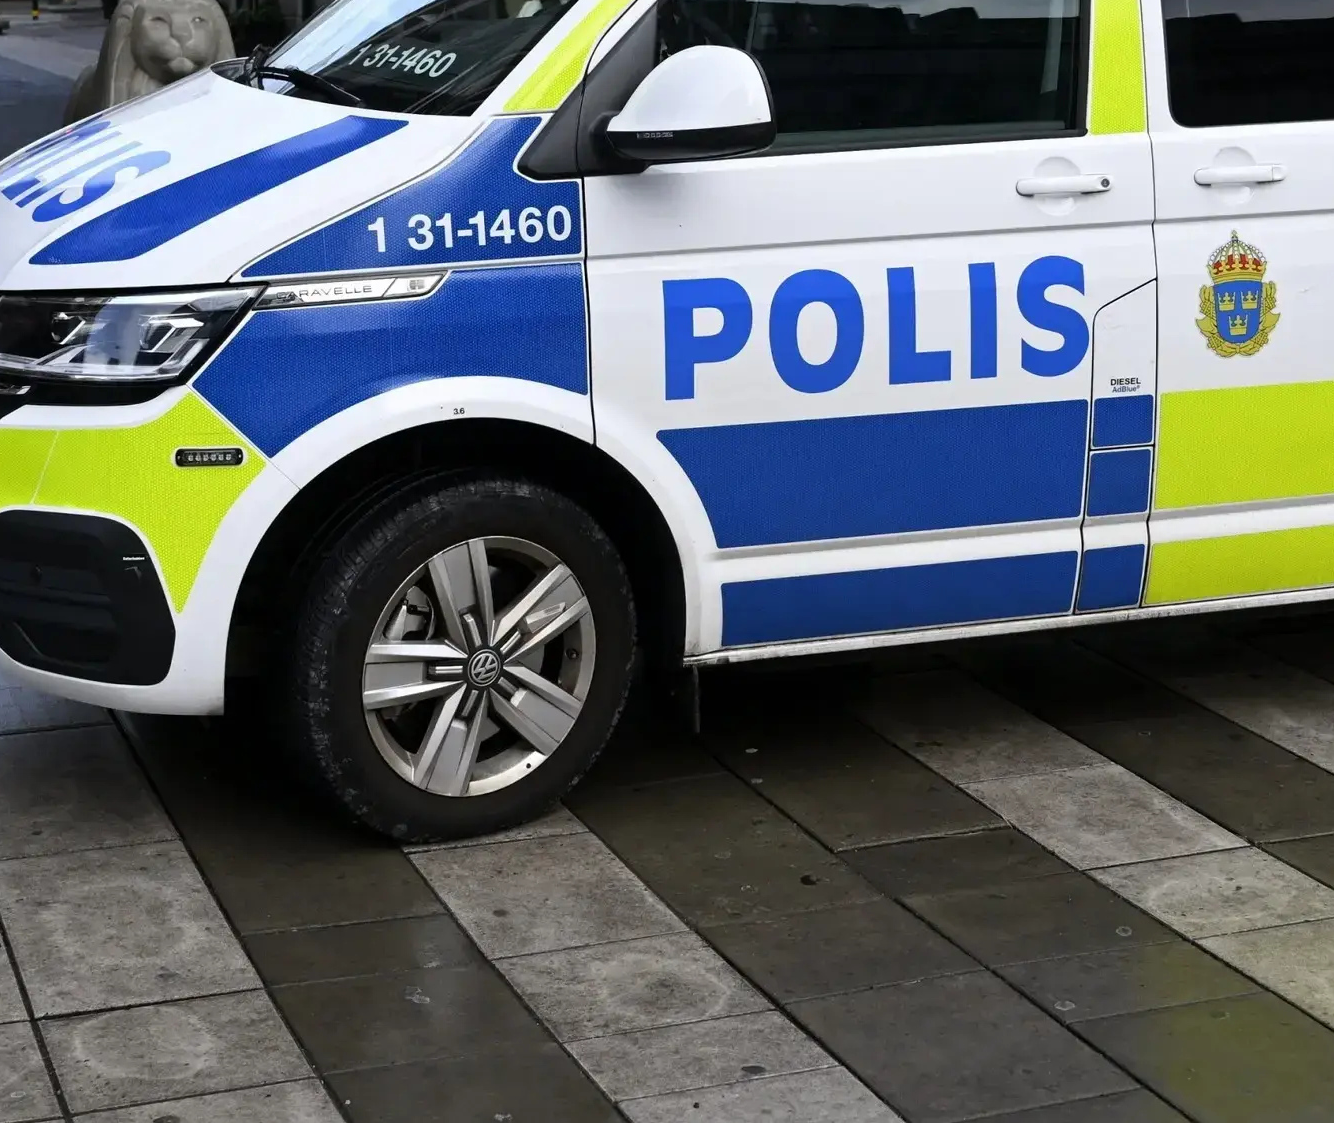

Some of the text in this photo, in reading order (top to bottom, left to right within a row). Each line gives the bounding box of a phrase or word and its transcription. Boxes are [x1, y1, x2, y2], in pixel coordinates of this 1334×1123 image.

[349, 44, 457, 78] 1 31-1460
[367, 205, 572, 253] 1 31-1460
[276, 284, 373, 300] CARAVELLE
[662, 255, 1090, 401] POLIS
[1110, 377, 1142, 386] DIESEL
[453, 407, 465, 415] 3.6
